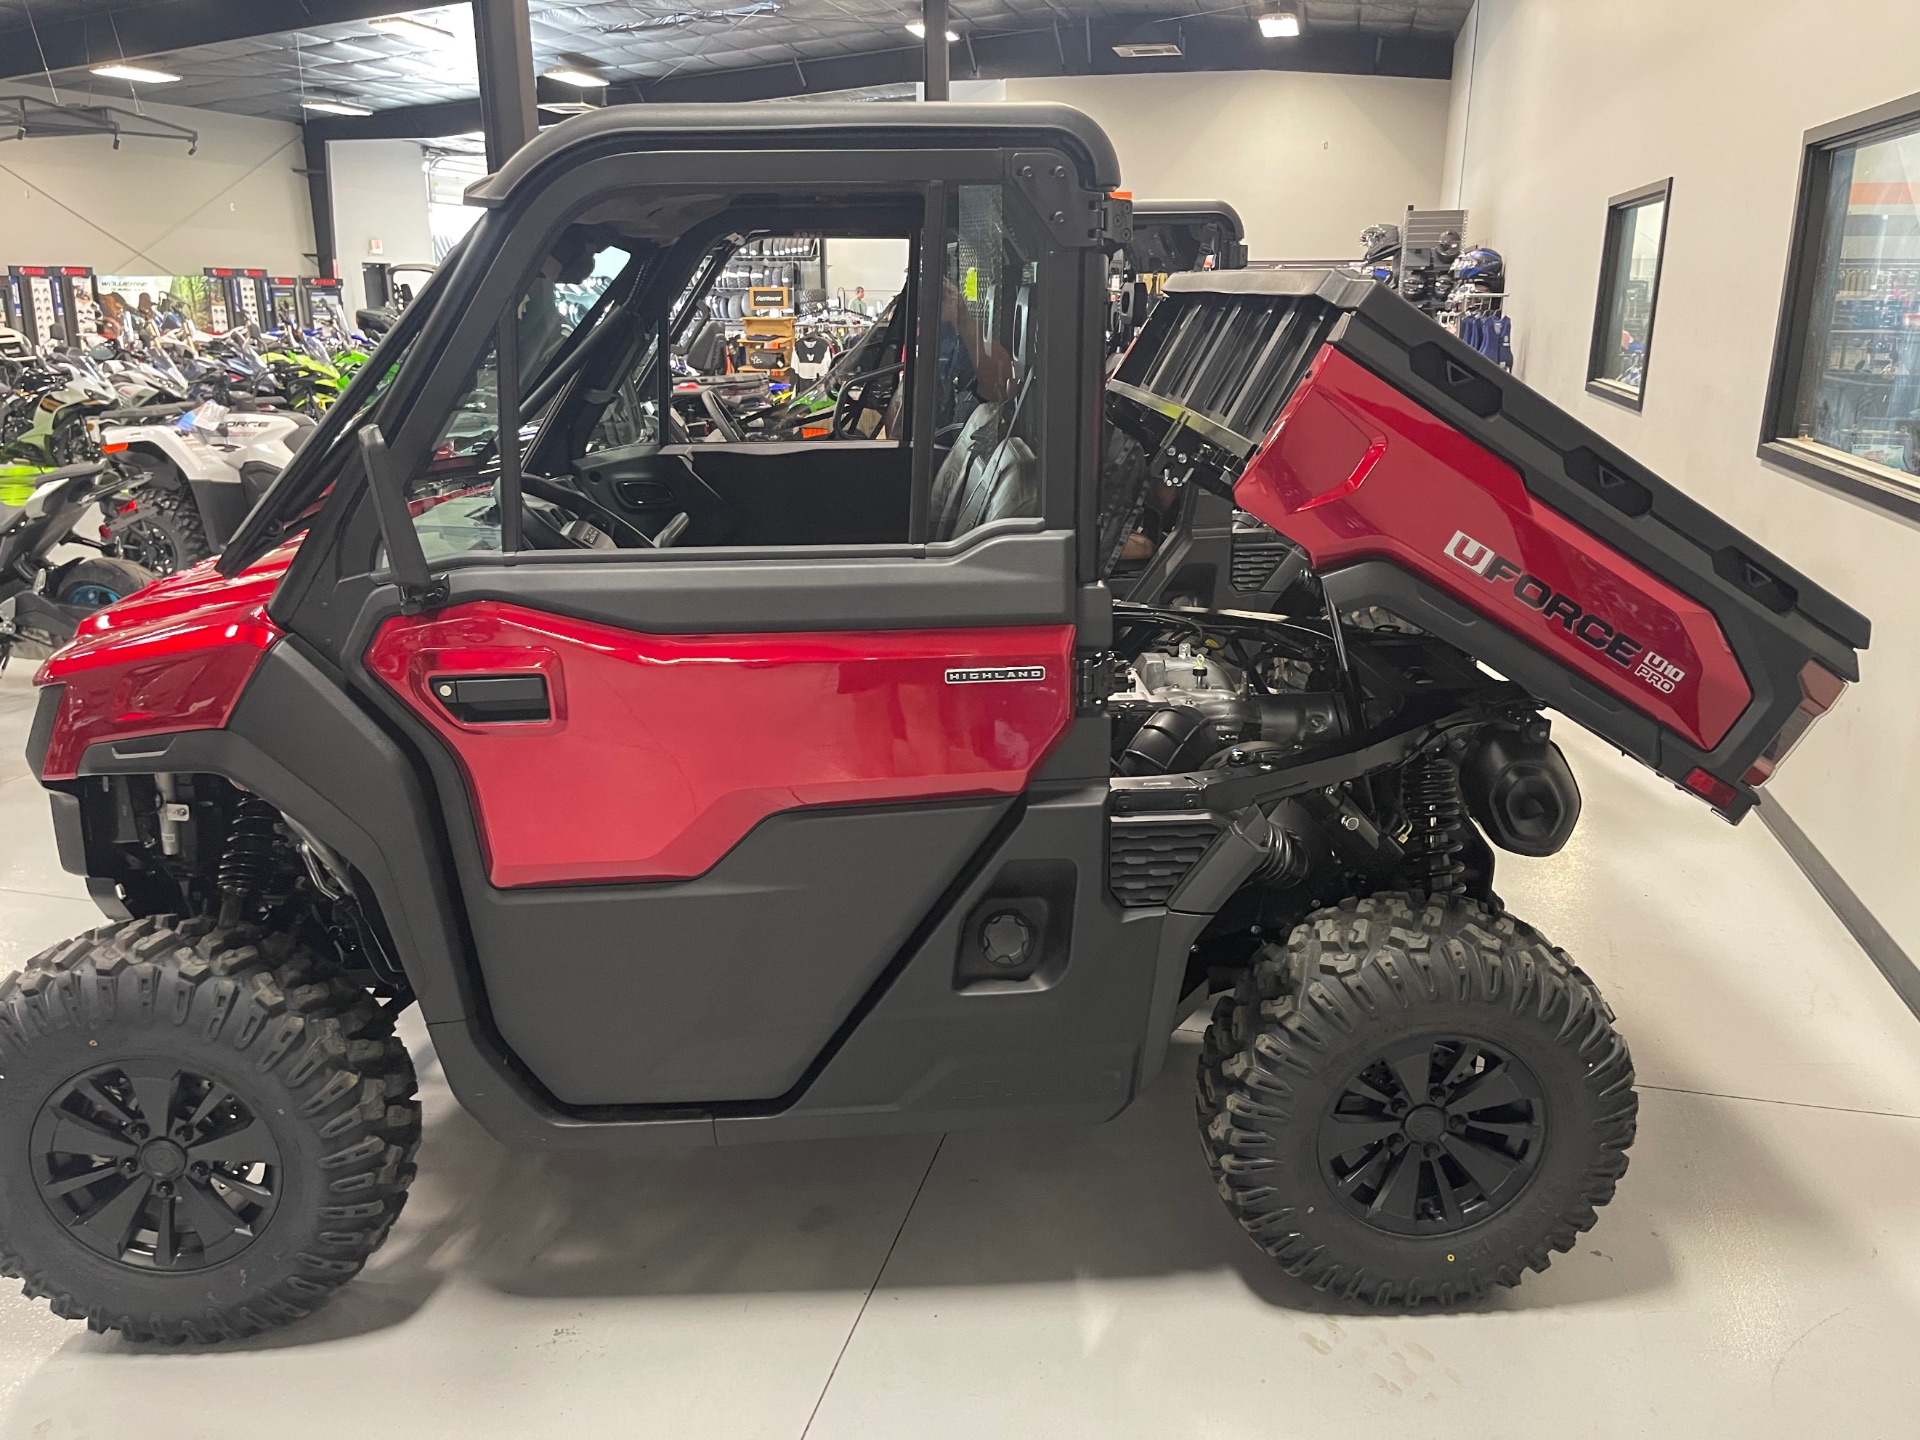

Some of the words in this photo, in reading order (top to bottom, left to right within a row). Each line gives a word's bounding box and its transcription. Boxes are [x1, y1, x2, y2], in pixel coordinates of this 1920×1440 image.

[949, 670, 1041, 680] HIGHLAND
[1633, 664, 1675, 694] PRO
[1643, 650, 1686, 683] U10
